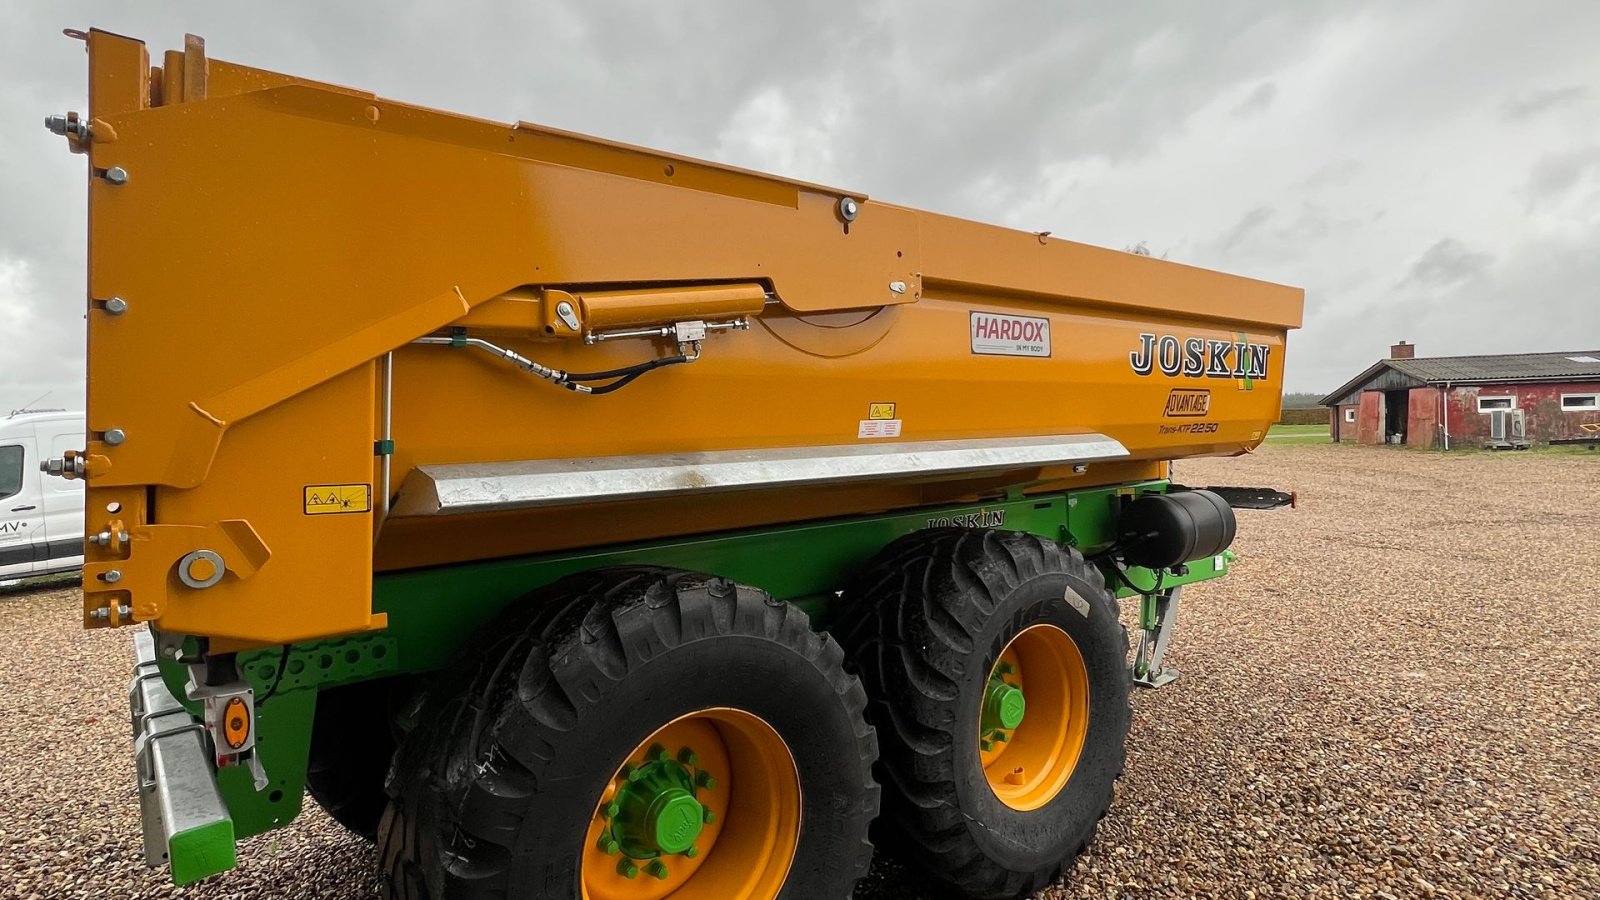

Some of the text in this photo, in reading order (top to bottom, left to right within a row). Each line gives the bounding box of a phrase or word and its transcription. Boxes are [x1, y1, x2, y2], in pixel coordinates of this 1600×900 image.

[976, 317, 1044, 342] HARDOX
[1130, 333, 1269, 379] JOSKIN
[1163, 394, 1208, 417] ADVANTAGE
